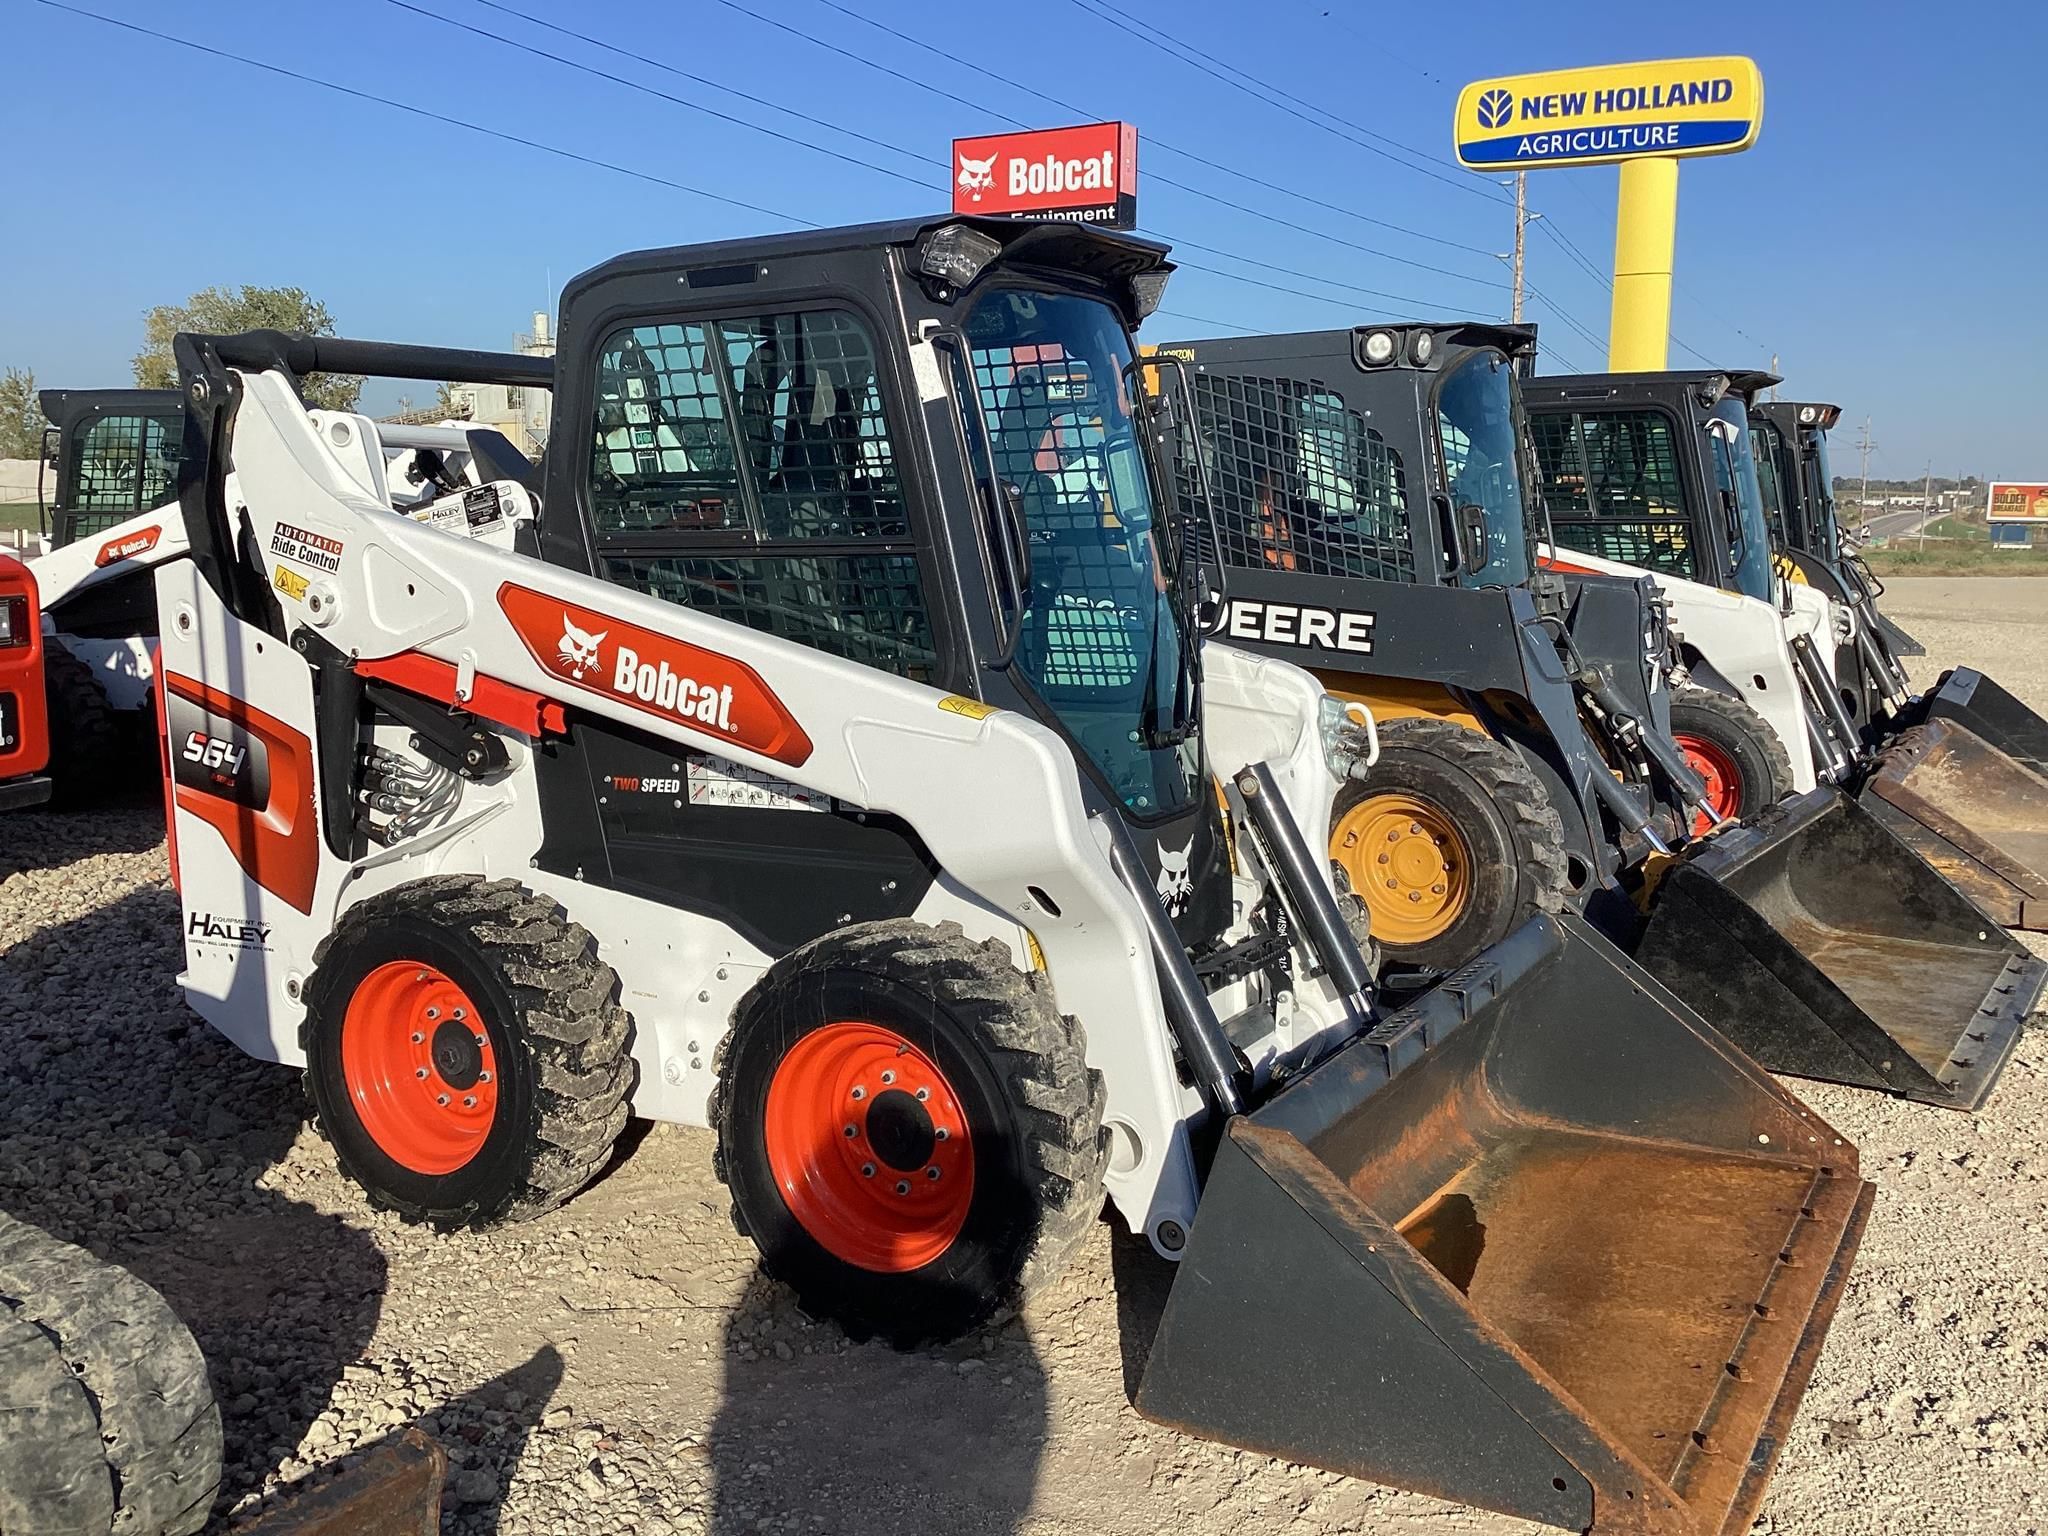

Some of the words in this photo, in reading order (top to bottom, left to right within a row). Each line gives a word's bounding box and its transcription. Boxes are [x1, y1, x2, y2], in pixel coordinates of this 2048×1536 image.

[1520, 91, 1587, 120] NEW
[1593, 78, 1733, 114] HOLLAND
[1516, 125, 1679, 156] AGRICULTURE
[1008, 150, 1114, 196] Bobcat
[1994, 494, 2026, 504] BOLDER
[121, 537, 150, 555] Bobcat
[271, 536, 296, 556] Ride
[298, 545, 341, 572] Control
[277, 524, 341, 554] AUTOMATIC
[1193, 591, 1374, 653] DEERE
[613, 646, 734, 731] Bobcat
[182, 732, 246, 775] S64
[612, 777, 640, 791] TWO
[641, 778, 681, 793] SPEED
[188, 911, 272, 944] HALEY
[212, 916, 255, 926] EQUIPMENT
